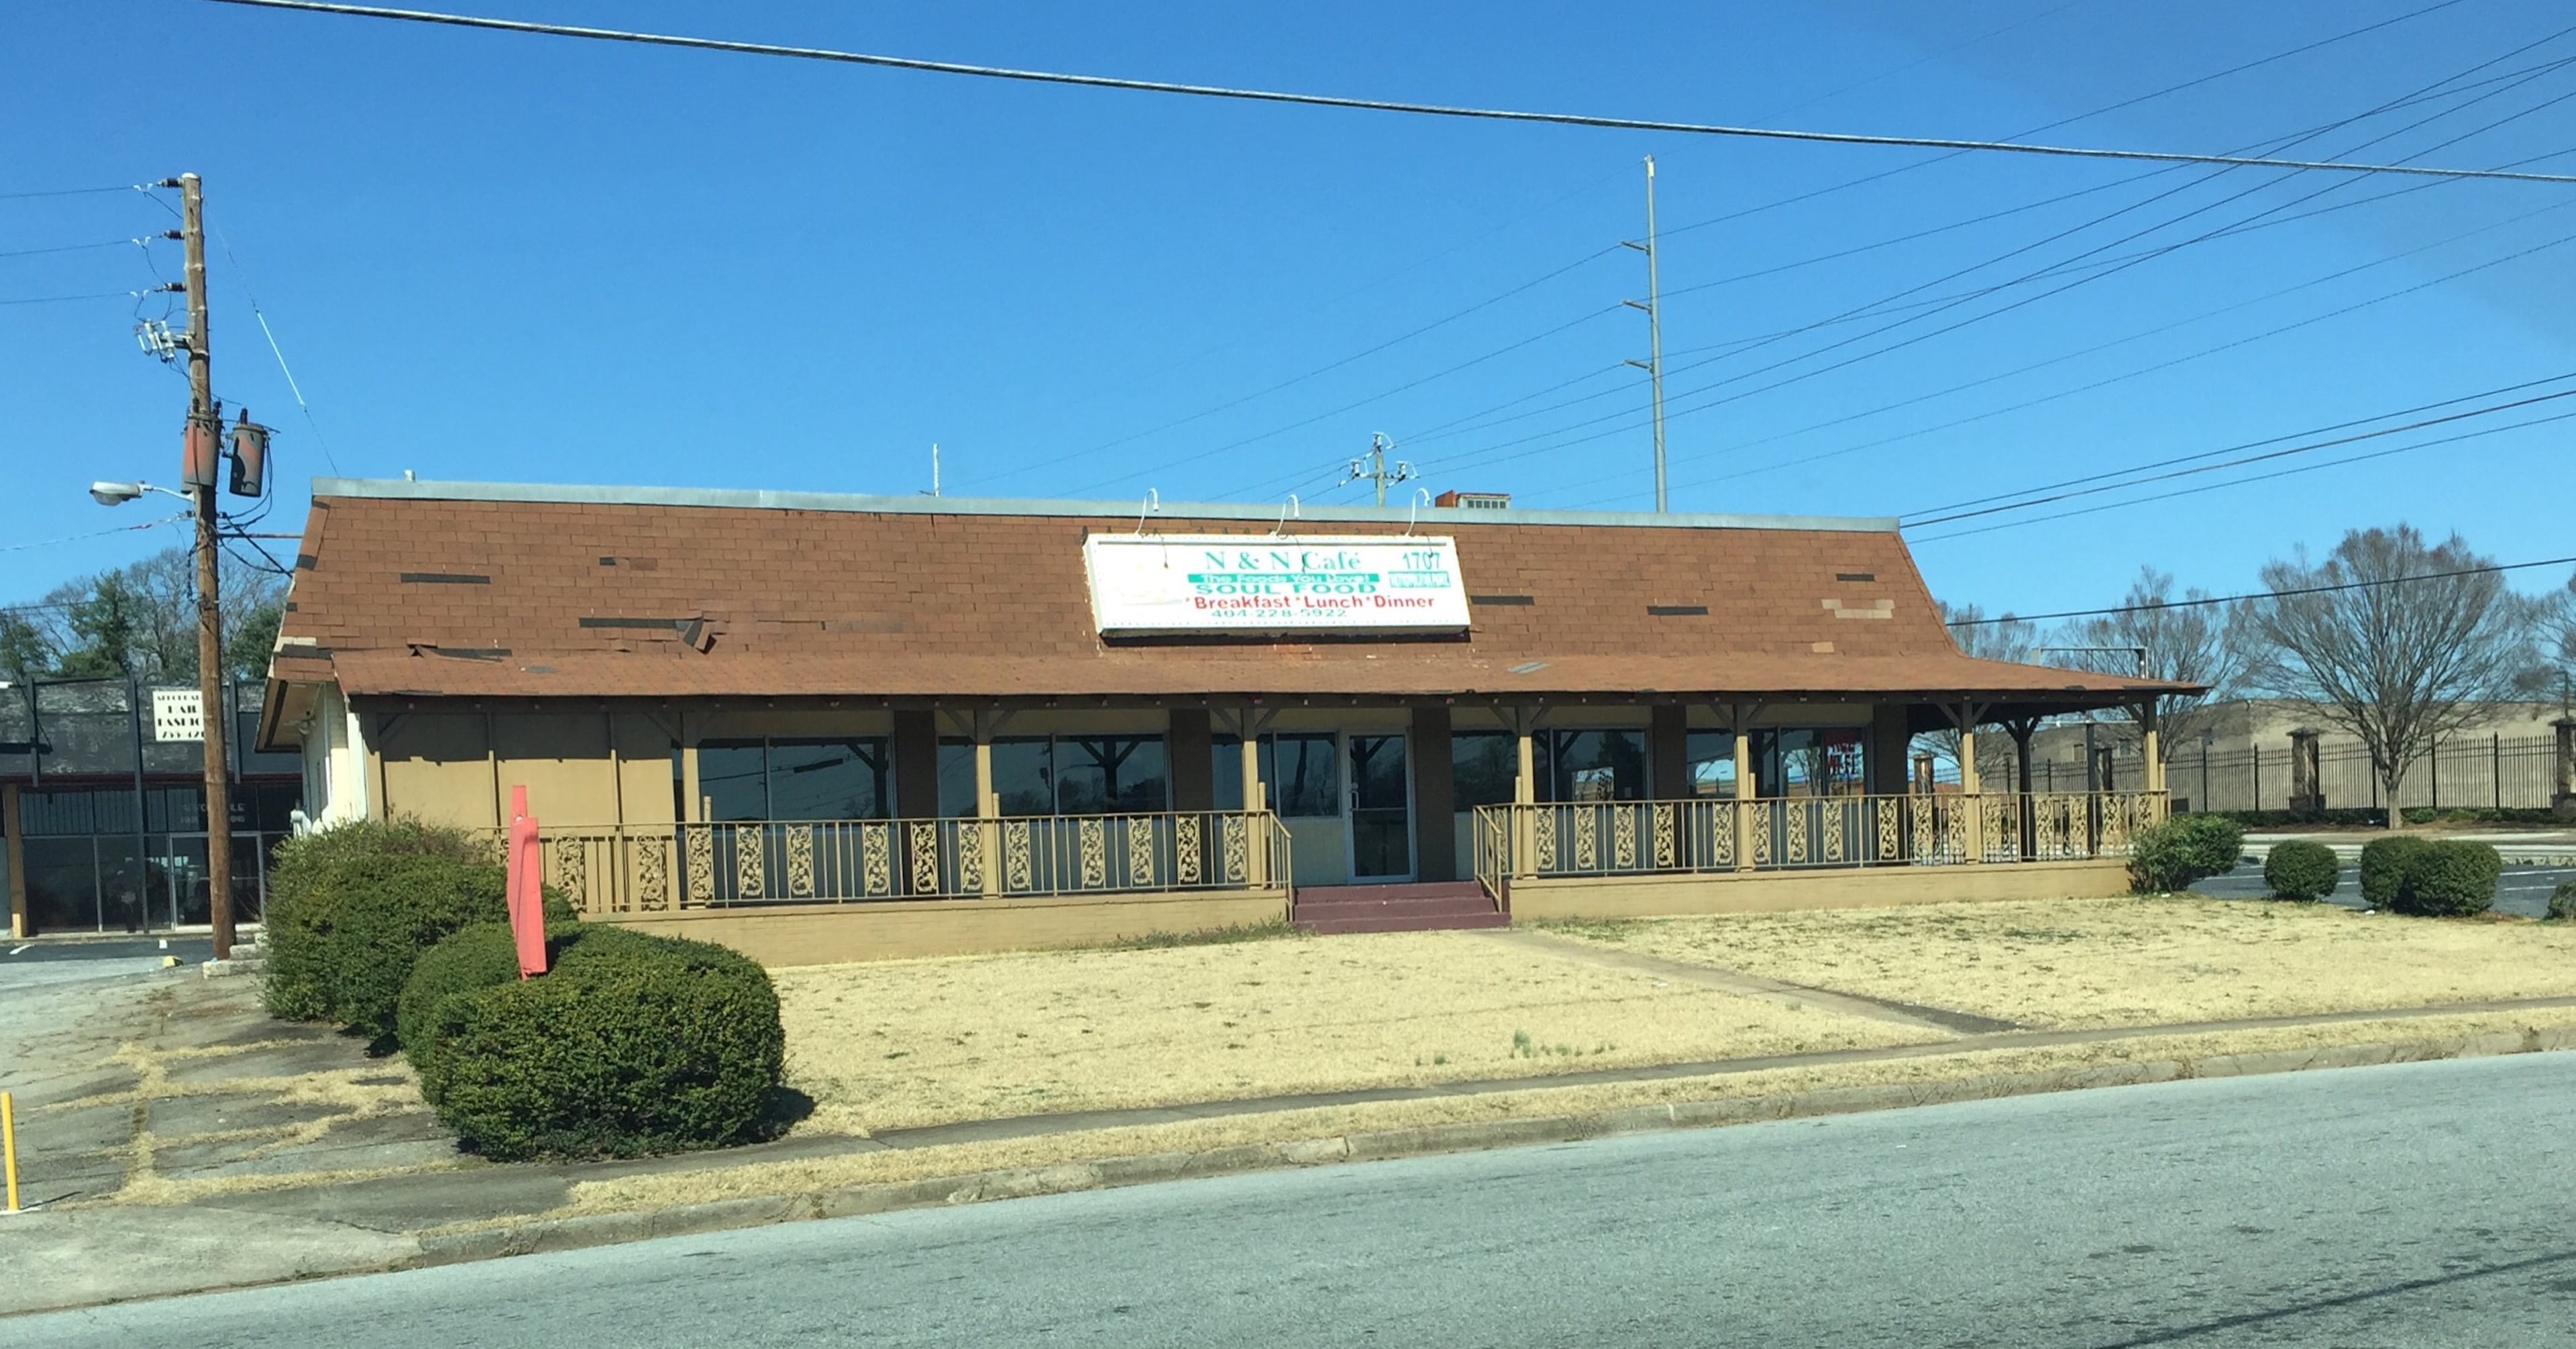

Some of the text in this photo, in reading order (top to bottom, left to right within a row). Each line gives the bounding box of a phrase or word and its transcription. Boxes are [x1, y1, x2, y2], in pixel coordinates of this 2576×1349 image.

[1205, 551, 1360, 570] N & N Café
[1403, 552, 1440, 570] 1707
[1196, 584, 1377, 594] SOUL FOOD
[1195, 595, 1434, 609] Breakfast Lunch Dinner
[158, 718, 203, 726] FASHIO
